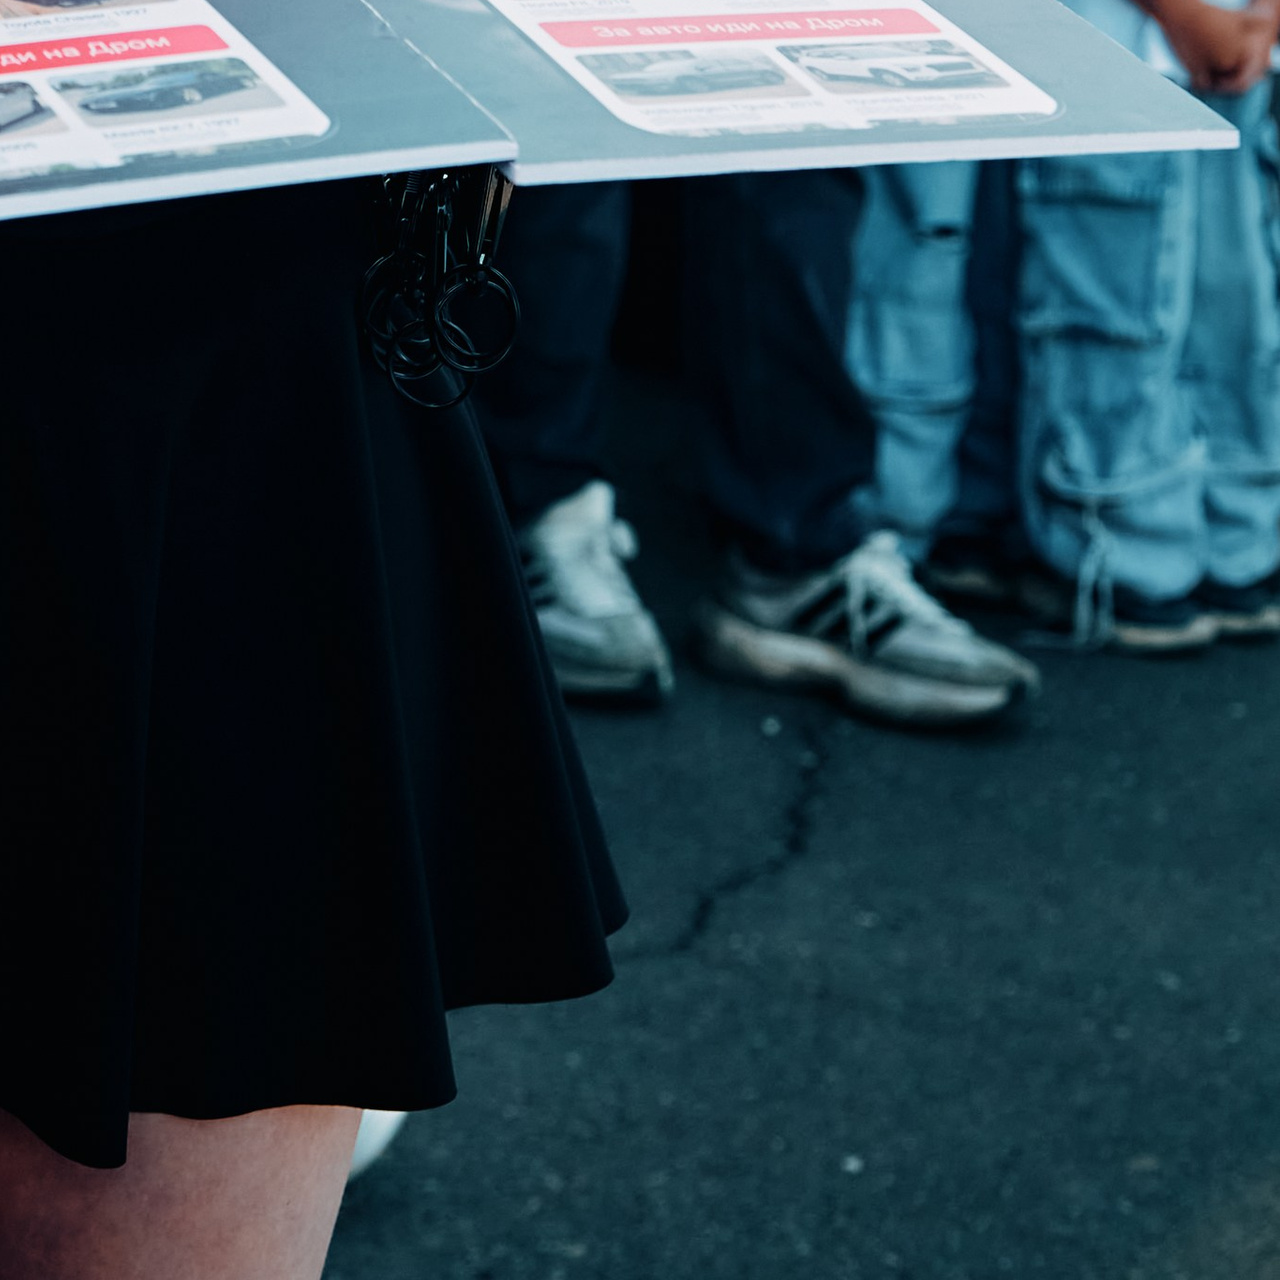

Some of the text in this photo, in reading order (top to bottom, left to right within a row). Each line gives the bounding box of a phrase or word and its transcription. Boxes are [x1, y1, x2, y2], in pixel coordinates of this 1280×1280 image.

[591, 14, 884, 39] За авто иди на Дром
[44, 44, 81, 61] на
[87, 34, 171, 58] Дром
